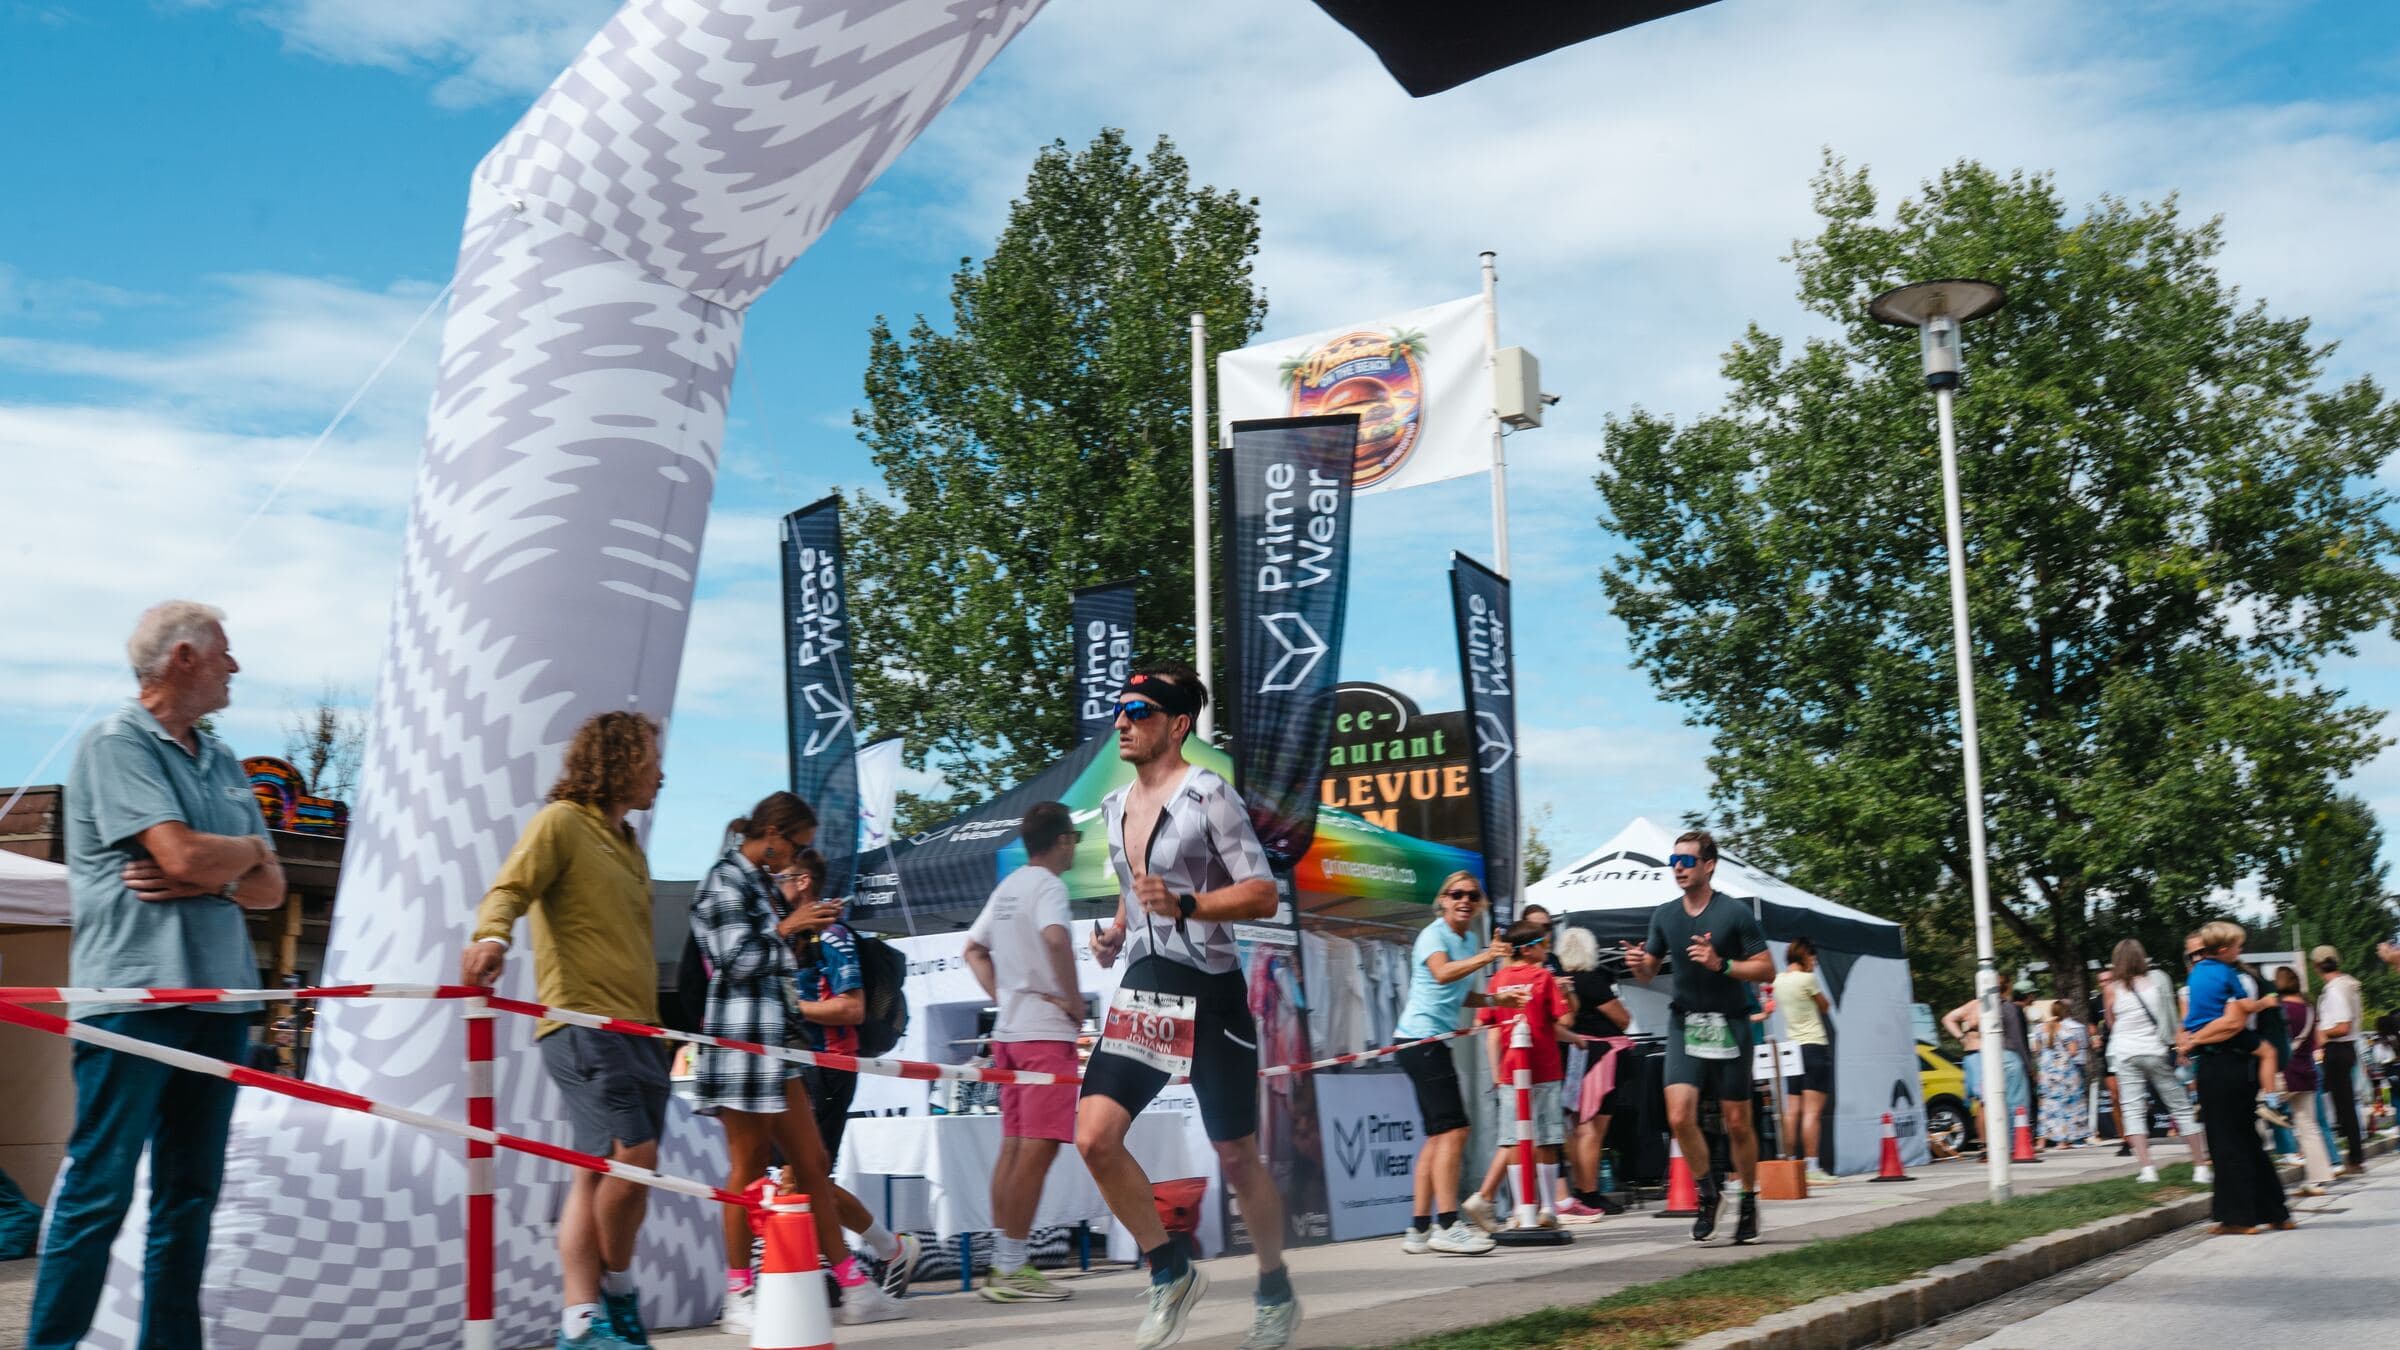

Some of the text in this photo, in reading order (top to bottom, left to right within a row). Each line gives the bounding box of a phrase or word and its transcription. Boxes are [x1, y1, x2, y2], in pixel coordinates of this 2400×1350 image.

[1256, 463, 1296, 592] Prime
[1297, 468, 1339, 588] Wear
[797, 548, 820, 666] Prime
[818, 550, 844, 655] Wear
[1081, 620, 1106, 720] Prime
[1336, 710, 1392, 733] ee-
[1329, 729, 1446, 766] aurant
[1321, 765, 1470, 807] LEVUE
[1557, 870, 1663, 888] skinfit
[1126, 1033, 1172, 1054] JOHANN
[1368, 1114, 1413, 1143] Prime
[1370, 1149, 1413, 1177] Wear
